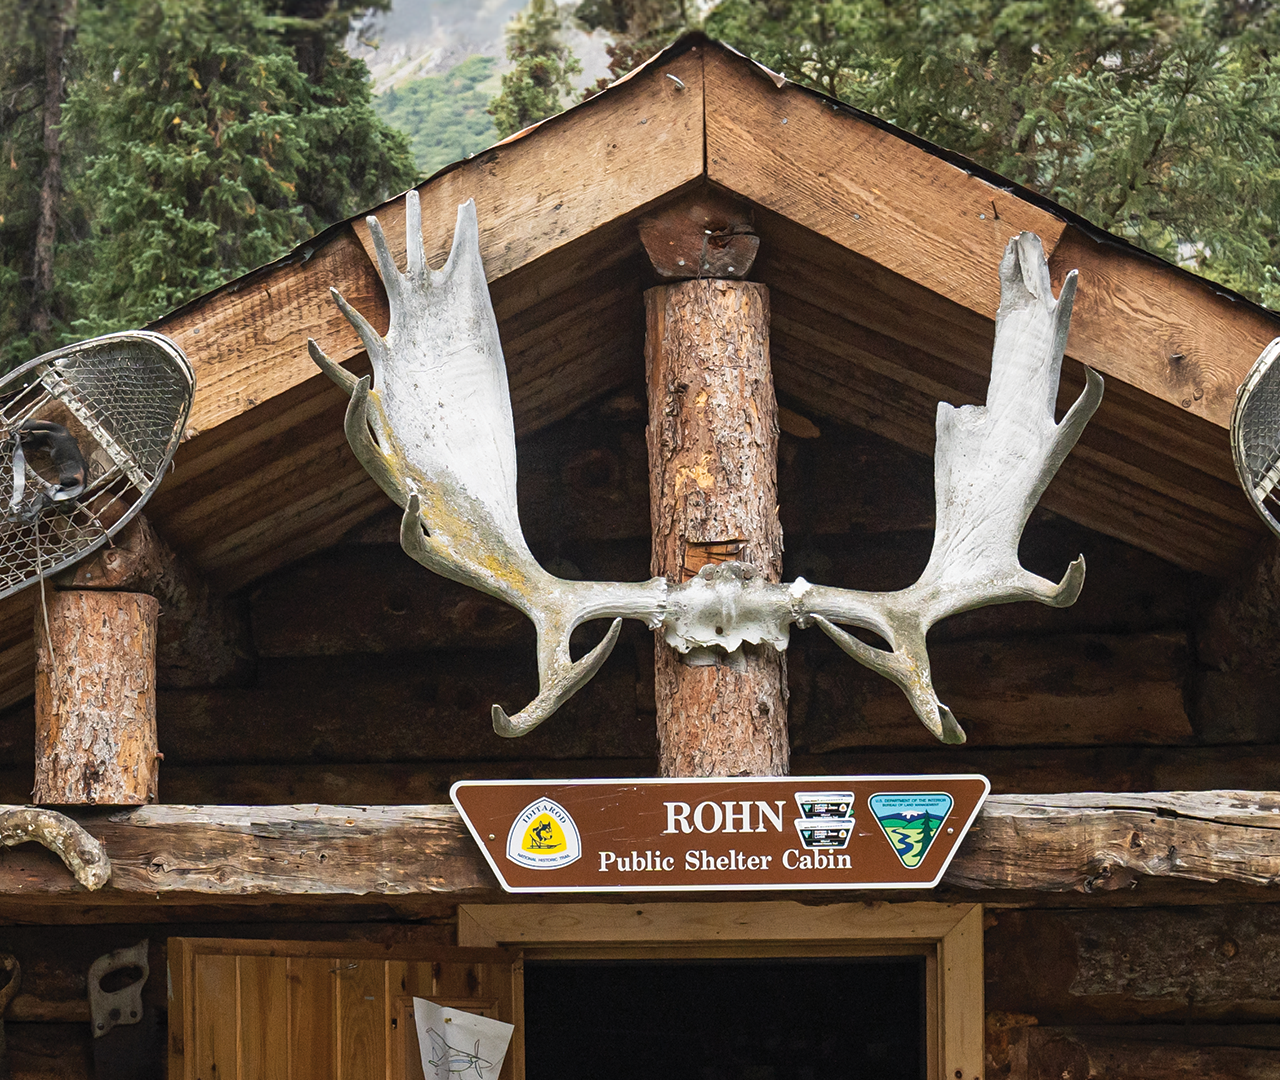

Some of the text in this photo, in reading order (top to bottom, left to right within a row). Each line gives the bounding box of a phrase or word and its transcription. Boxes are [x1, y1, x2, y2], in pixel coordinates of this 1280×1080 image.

[522, 804, 567, 824] IDITAROD
[663, 801, 786, 834] ROHN
[517, 853, 537, 862] NATIONAL
[598, 848, 853, 872] Public Shelter Cabin
